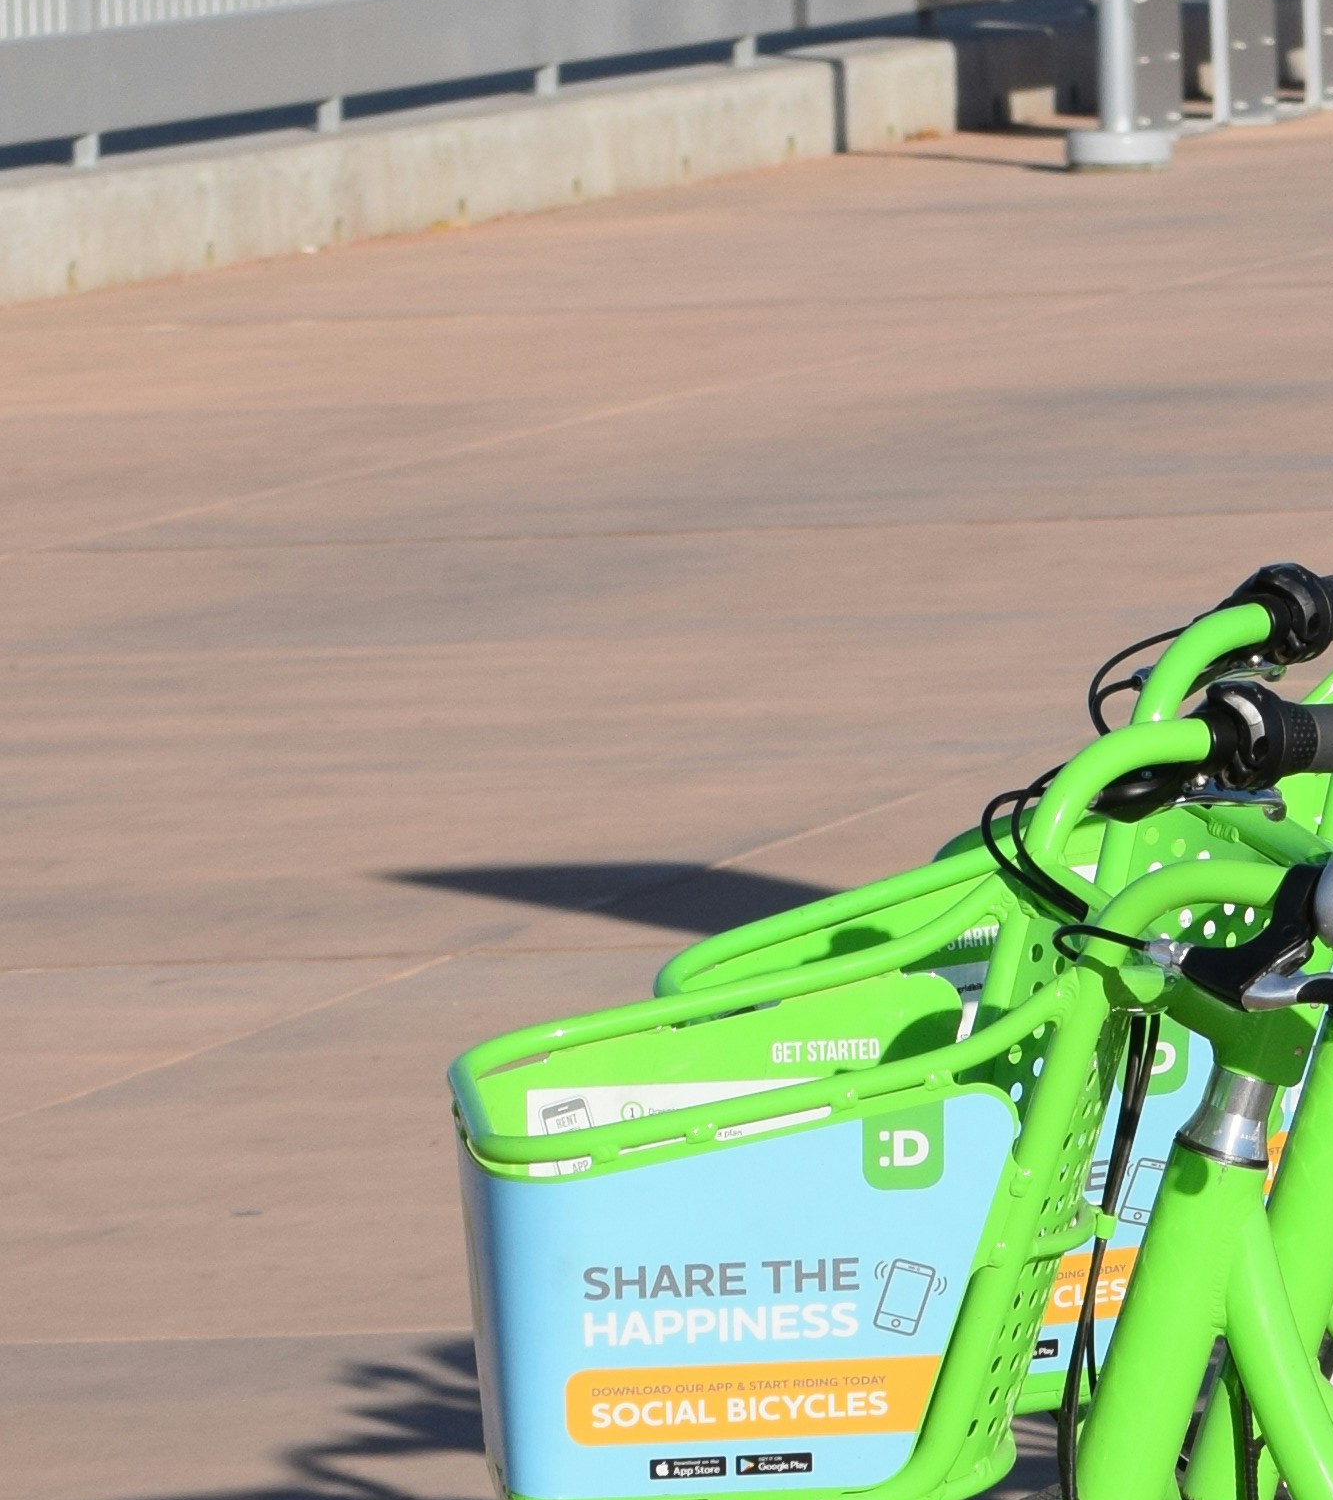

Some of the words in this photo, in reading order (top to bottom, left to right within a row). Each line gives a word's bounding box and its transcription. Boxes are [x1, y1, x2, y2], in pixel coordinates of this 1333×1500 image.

[772, 1042, 802, 1063] GET
[807, 1038, 880, 1062] STARTED
[556, 1114, 578, 1129] RENT
[724, 1128, 743, 1139] plan
[572, 1160, 589, 1174] APP
[583, 1262, 747, 1301] SHARE
[761, 1257, 860, 1294] THE
[583, 1301, 860, 1348] HAPPINESS
[591, 1383, 672, 1397] DOWNLOAD
[676, 1382, 704, 1394] OUR
[708, 1381, 733, 1393] APP
[737, 1381, 745, 1391] &
[749, 1379, 789, 1391] START
[793, 1376, 839, 1389] RIDING
[842, 1374, 886, 1387] TODAY
[591, 1398, 716, 1429] SOCIAL
[727, 1390, 889, 1423] BICYCLES
[673, 1465, 696, 1478] App
[697, 1463, 721, 1475] Store
[758, 1460, 791, 1473] Google
[792, 1458, 808, 1472] Play
